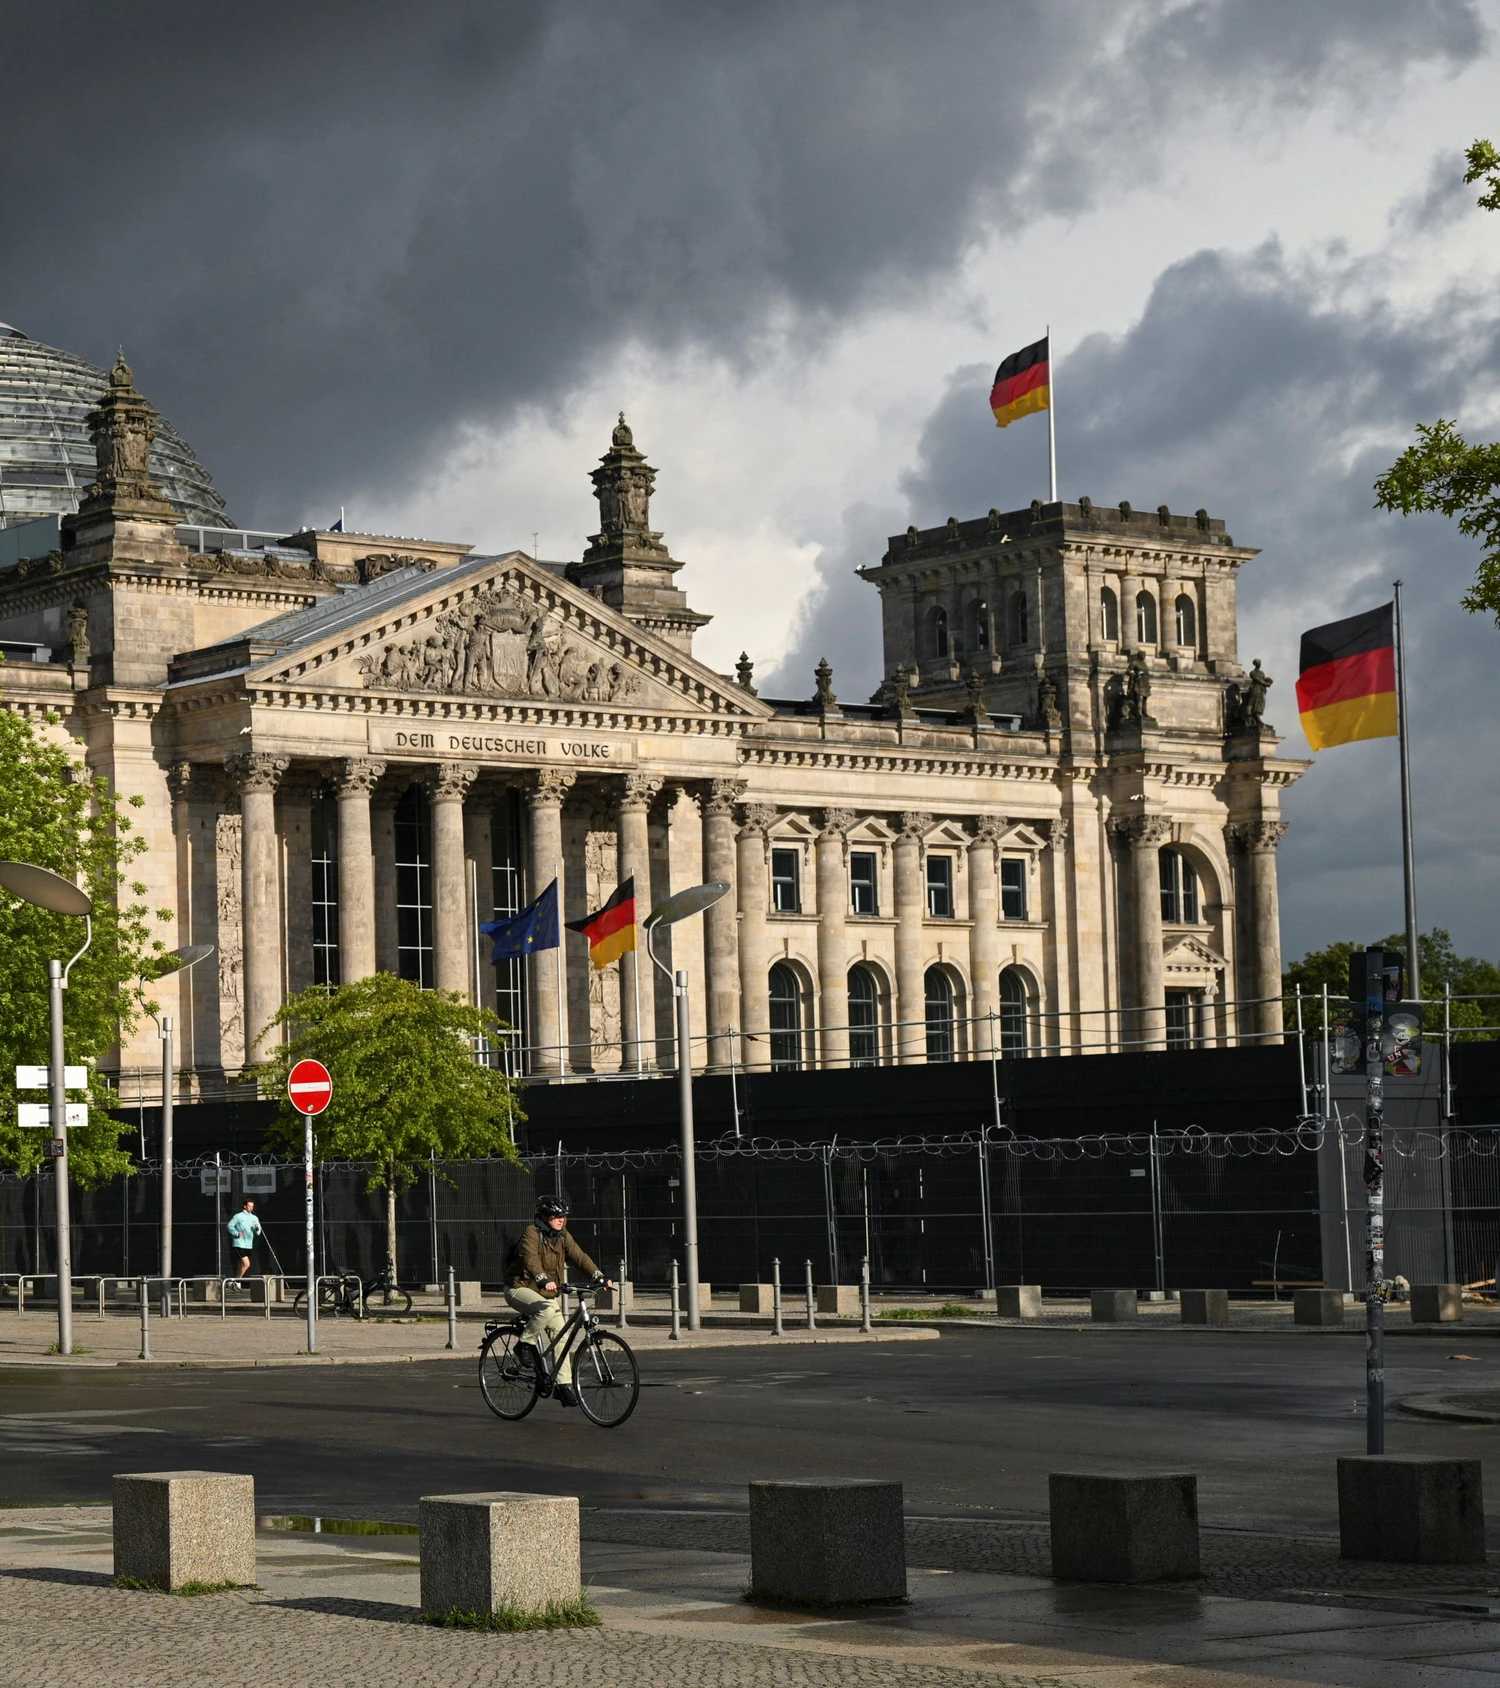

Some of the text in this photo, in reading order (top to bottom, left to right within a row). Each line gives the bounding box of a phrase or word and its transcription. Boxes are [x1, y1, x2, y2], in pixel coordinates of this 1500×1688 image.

[395, 732, 610, 759] DEM DEUTSCHEN VOLKE
